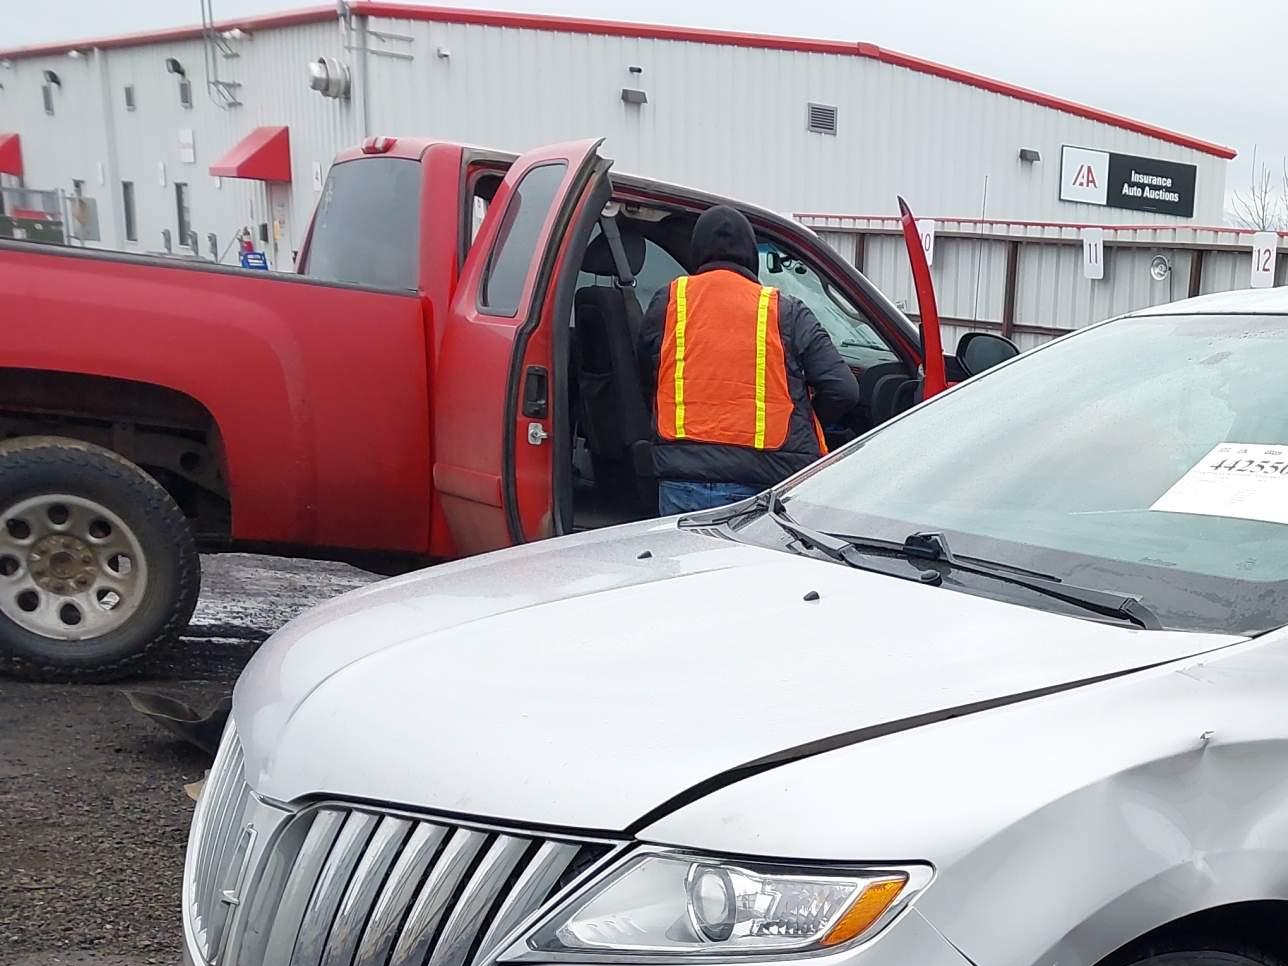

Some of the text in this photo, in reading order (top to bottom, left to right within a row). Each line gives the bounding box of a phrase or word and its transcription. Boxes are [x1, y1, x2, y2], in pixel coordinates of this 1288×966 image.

[1131, 169, 1172, 187] Insurance
[1122, 183, 1179, 202] Auto Auctions
[1088, 242, 1098, 265] 11
[1256, 247, 1272, 272] 12
